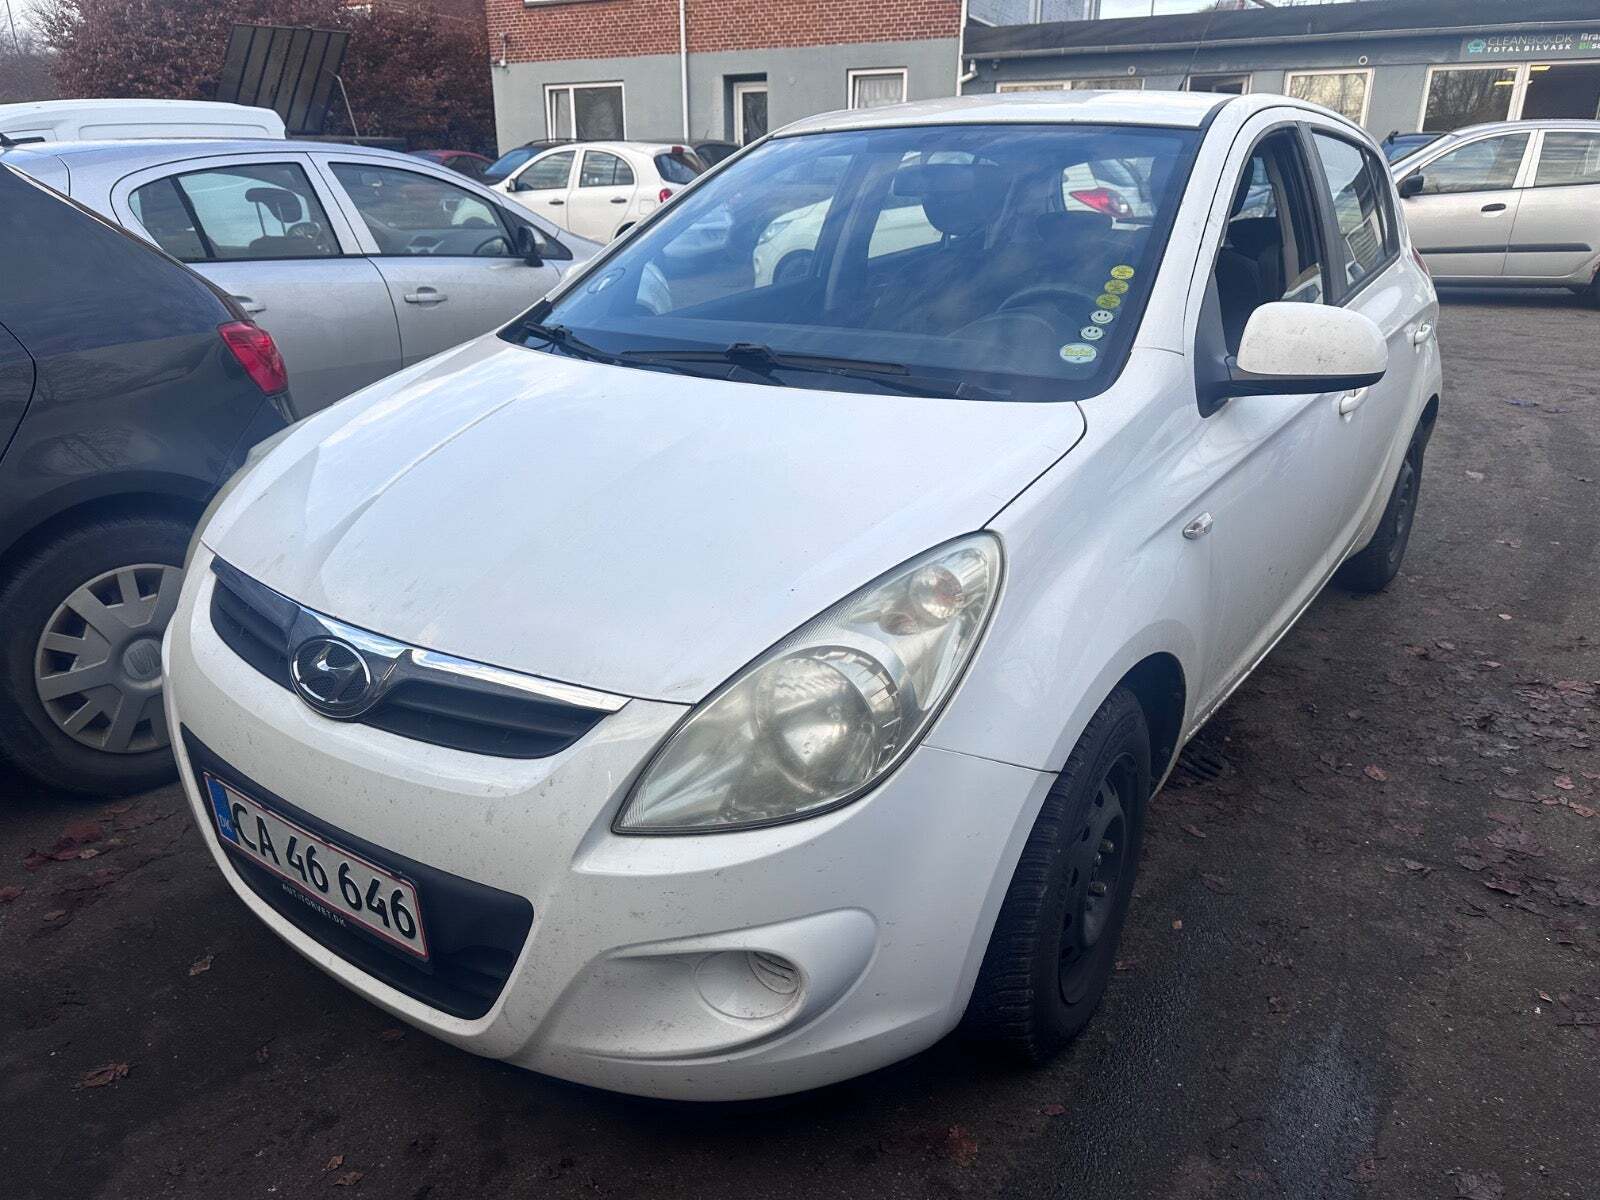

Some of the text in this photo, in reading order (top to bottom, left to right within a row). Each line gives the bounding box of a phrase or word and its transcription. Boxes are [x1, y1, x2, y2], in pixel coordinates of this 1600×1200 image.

[231, 803, 417, 940] CA 46 646
